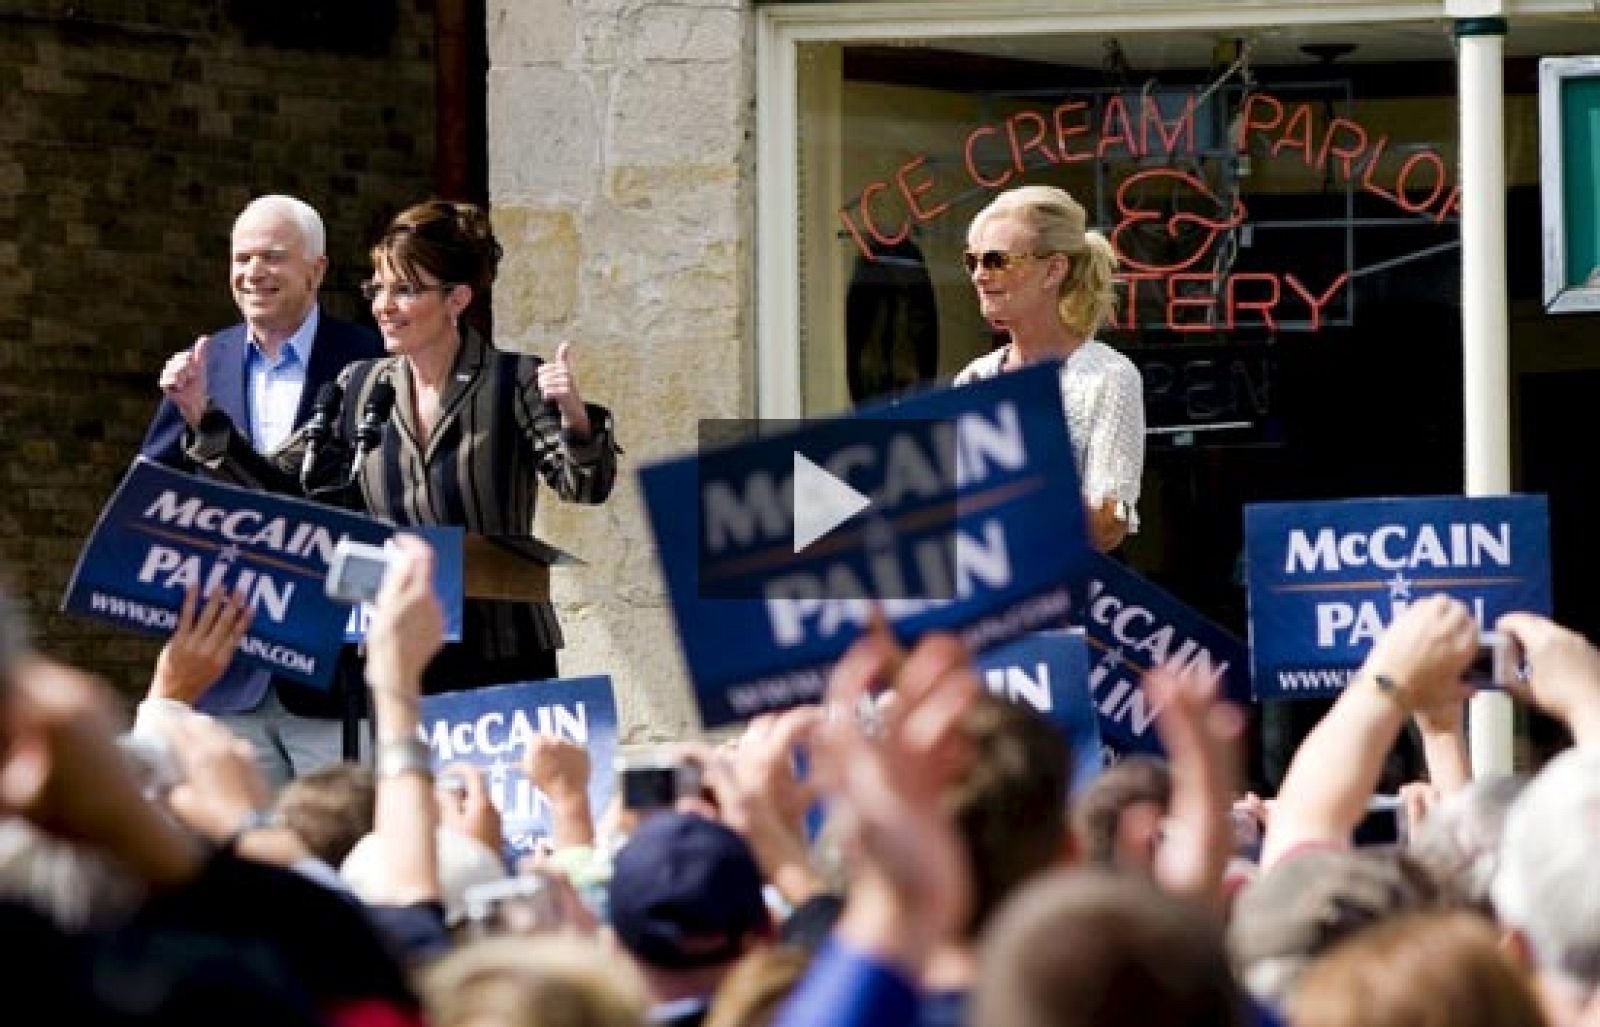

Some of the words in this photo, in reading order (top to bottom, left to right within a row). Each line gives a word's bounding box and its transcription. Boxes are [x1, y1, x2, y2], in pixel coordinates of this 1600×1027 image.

[839, 156, 949, 261] ICE
[964, 94, 1197, 187] CREAM
[1111, 168, 1247, 271] &
[1106, 272, 1350, 331] TERY
[143, 489, 348, 564] McCAIN
[1285, 522, 1511, 573] McCAIN
[1089, 579, 1230, 693] cCAIN
